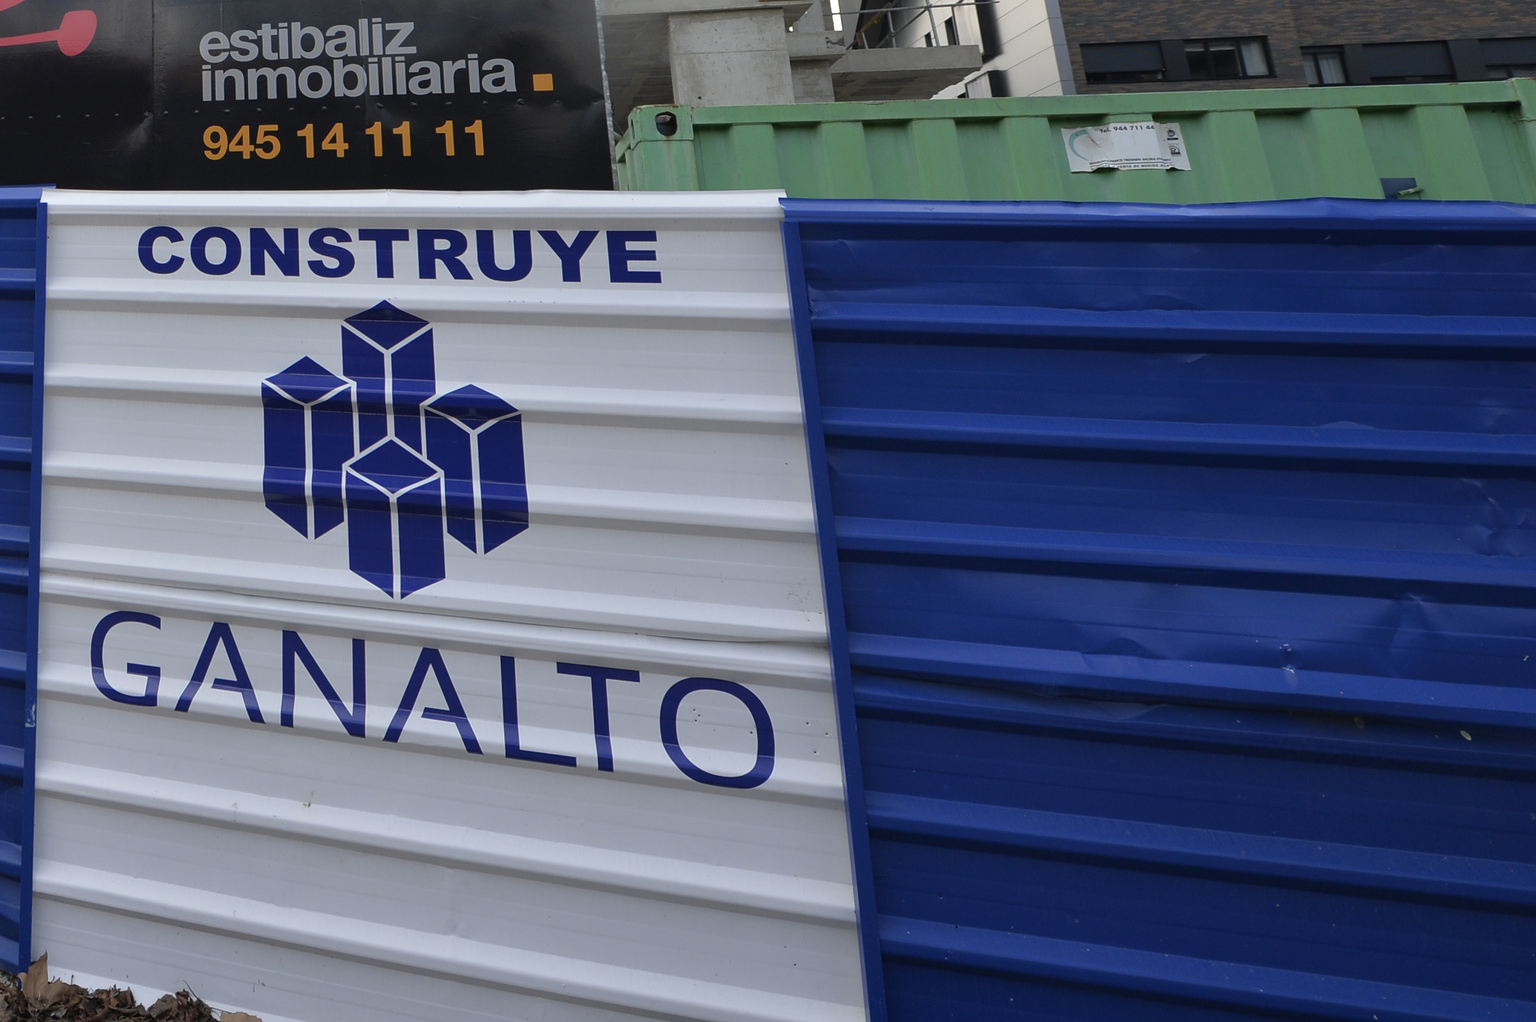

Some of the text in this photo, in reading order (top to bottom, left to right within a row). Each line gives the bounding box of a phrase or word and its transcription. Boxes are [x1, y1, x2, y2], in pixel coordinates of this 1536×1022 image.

[199, 17, 417, 64] estibaliz
[201, 53, 517, 102] inmobiliaria
[202, 119, 485, 162] 945 14 11 11
[137, 225, 662, 284] CONSTRUYE
[90, 610, 776, 790] GANALTO
